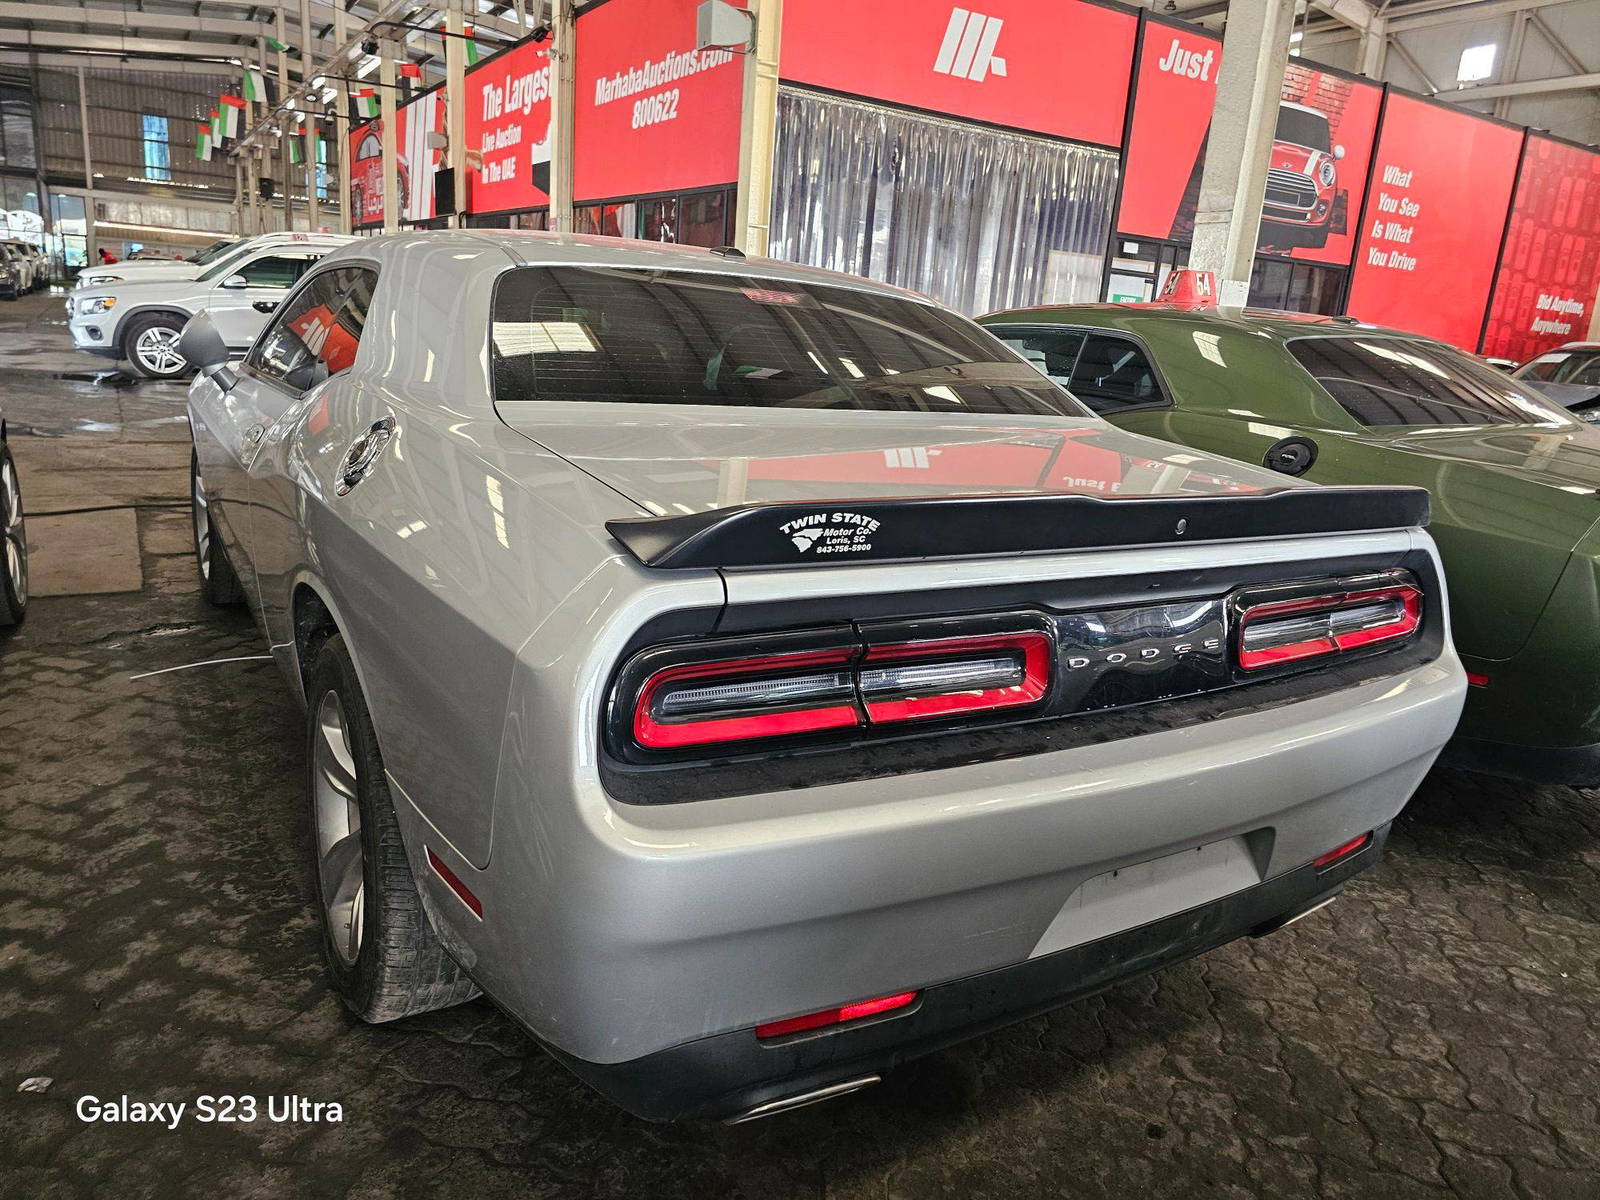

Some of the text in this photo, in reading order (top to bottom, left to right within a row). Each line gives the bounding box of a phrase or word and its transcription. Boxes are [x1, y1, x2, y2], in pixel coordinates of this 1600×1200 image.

[1159, 38, 1214, 82] Just
[594, 47, 734, 106] MarhabaAuctions.com
[482, 83, 503, 121] The
[632, 88, 680, 129] 800622
[482, 123, 522, 153] Live Auction
[489, 161, 501, 182] The
[501, 156, 517, 180] UAE
[1382, 165, 1413, 188] What
[1378, 192, 1420, 217] You See
[1371, 219, 1413, 243] Is What
[1367, 247, 1417, 271] You Drive
[1535, 294, 1584, 317] Bid Anytime,
[1530, 316, 1571, 335] Anywhere
[780, 512, 881, 534] TWIN STATE
[823, 526, 872, 537] Motor Co.
[816, 543, 872, 554] 843-756-5900
[826, 535, 866, 545] Loris, SC
[1068, 639, 1219, 669] DODGE
